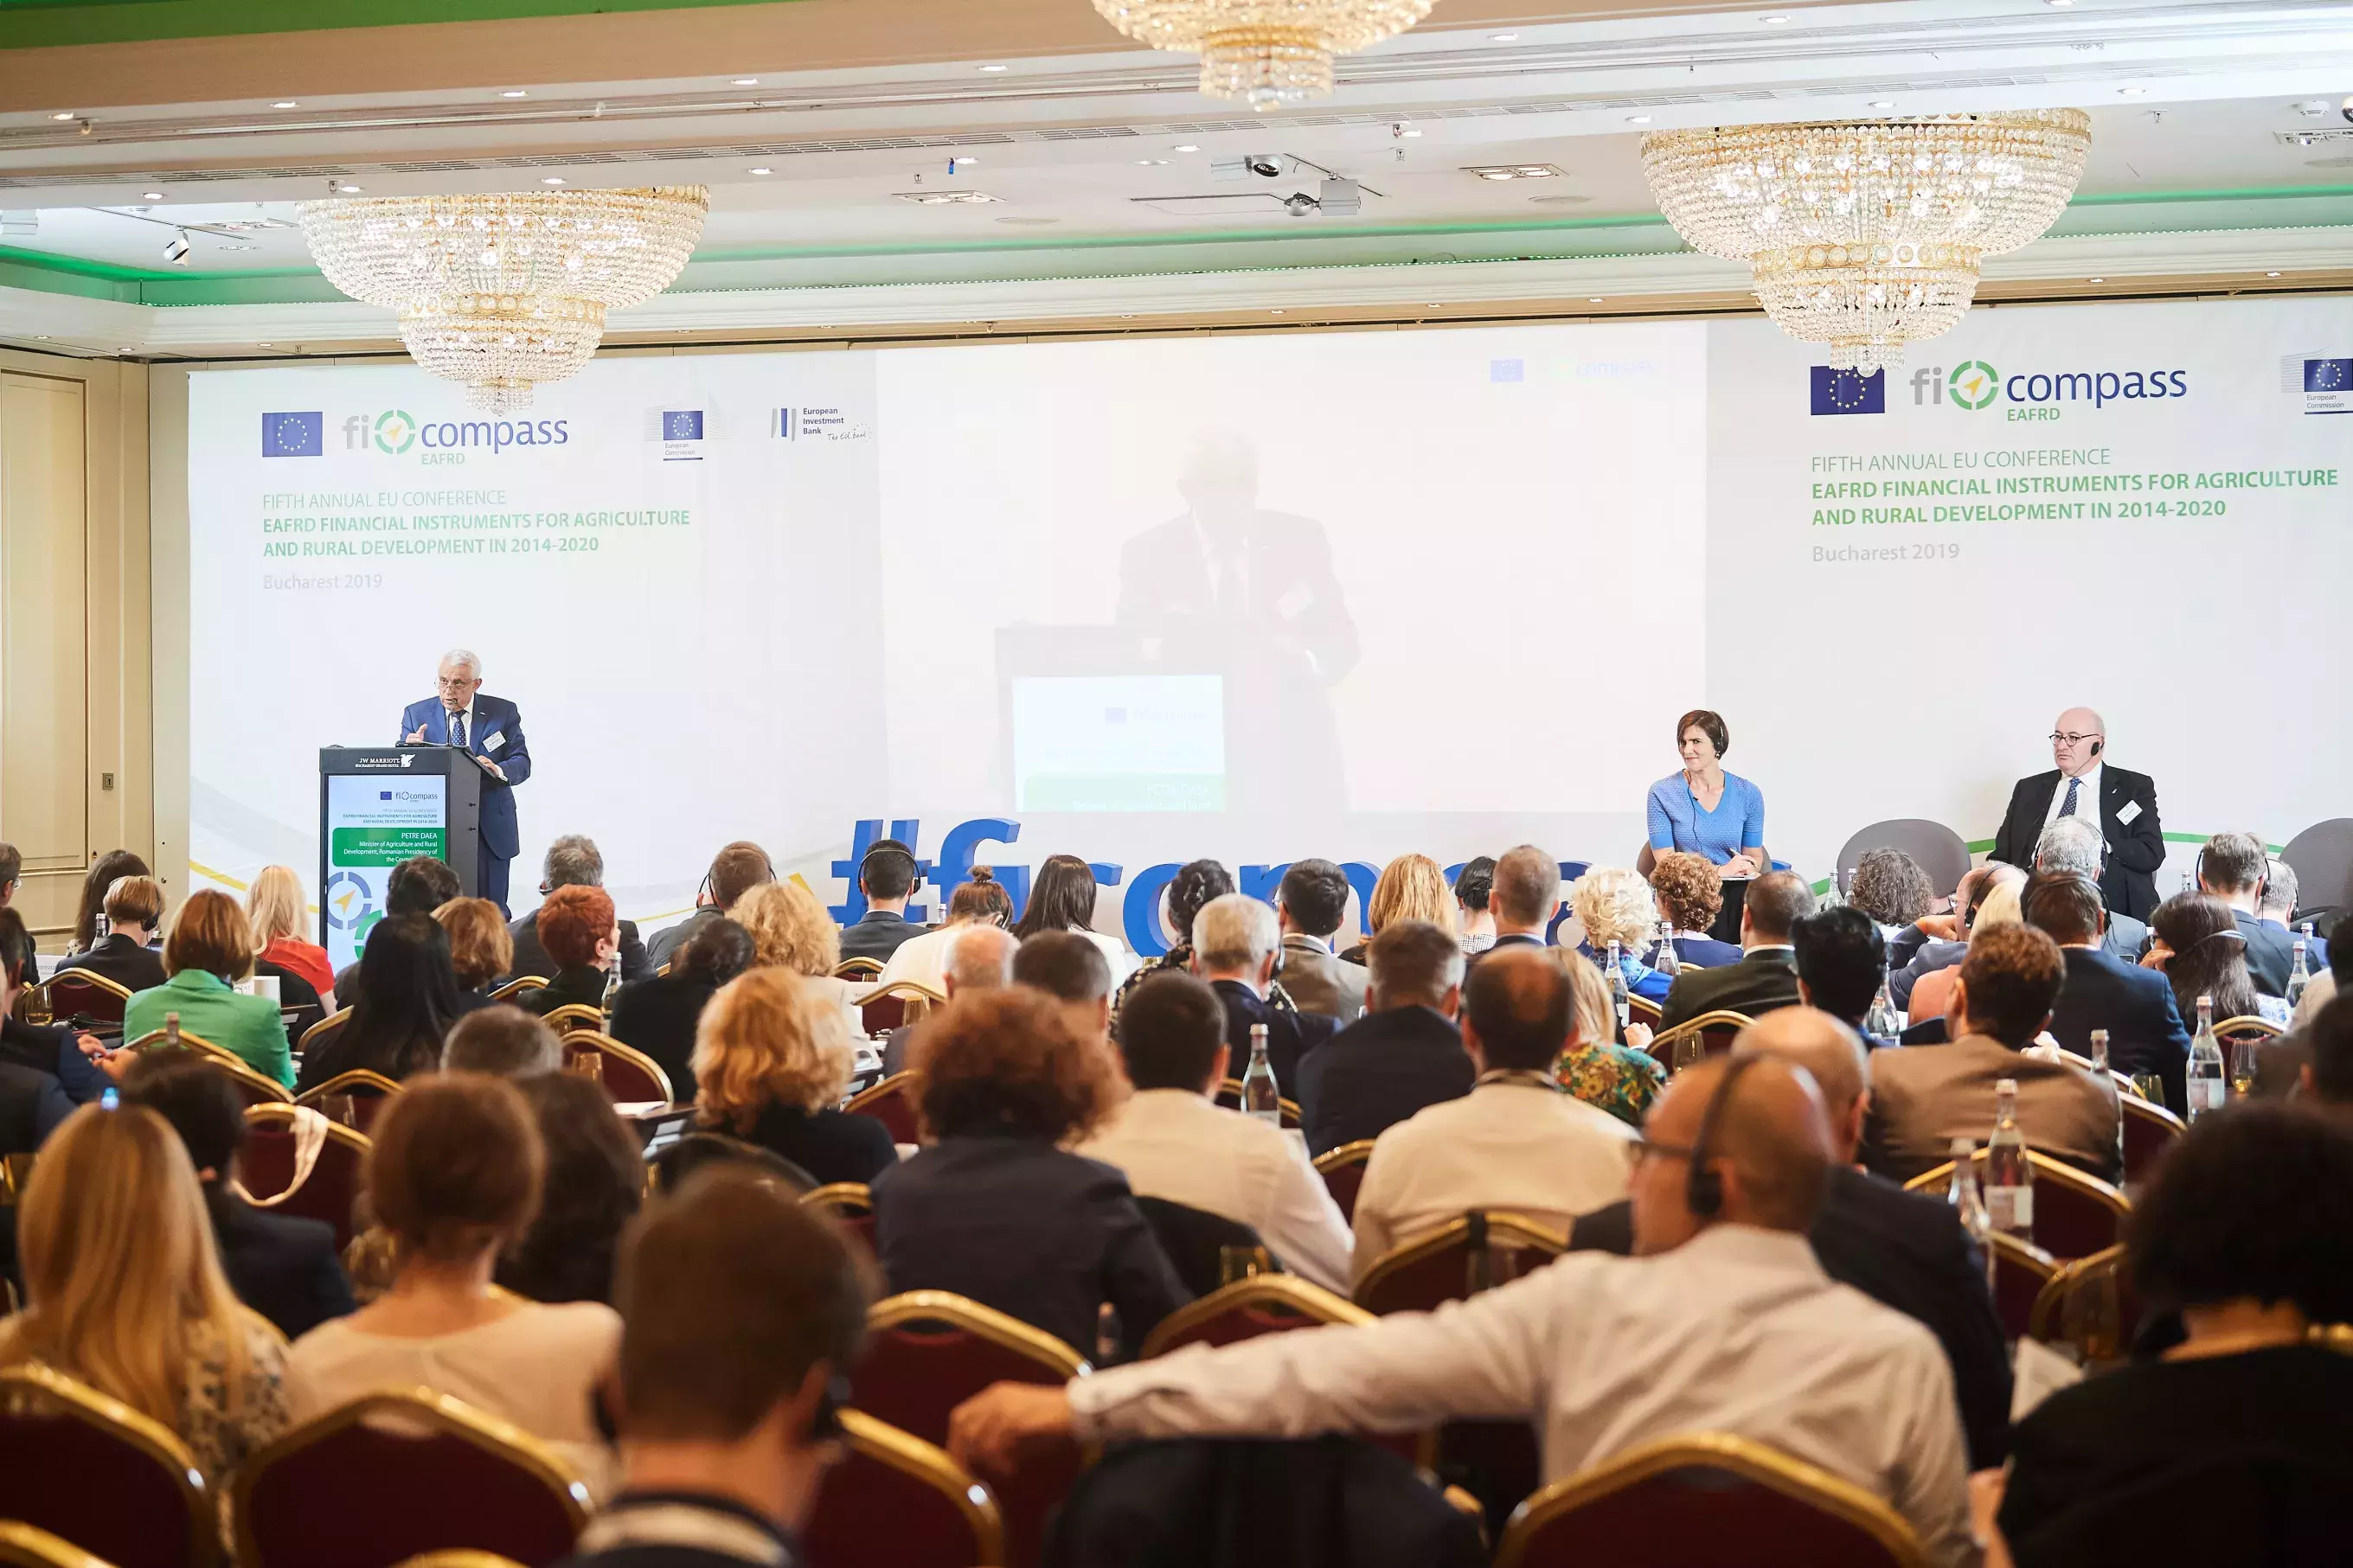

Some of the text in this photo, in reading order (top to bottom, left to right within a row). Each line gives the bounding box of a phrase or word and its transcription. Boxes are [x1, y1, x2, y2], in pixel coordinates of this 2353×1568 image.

[1909, 367, 2188, 409] fi compass
[803, 407, 838, 417] European
[803, 417, 844, 426] Investment
[2006, 408, 2061, 422] EAFRD
[342, 414, 568, 454] fi compass
[421, 452, 465, 465] EAFRD
[1812, 449, 2111, 473] FIFTH ANNUAL EU CONFERENCE
[1812, 469, 2338, 499] EAFRD FINANCIAL INSTRUMENTS FOR AGRICULTURE
[263, 490, 507, 510] FIFTH ANNUAL EU CONFERENCE
[263, 510, 690, 533] EAFRD FINANCIAL INSTRUMENTS FOR AGRICULTURE
[1812, 500, 2226, 526] AND RURAL DEVELOPMENT IN 2014-2020
[263, 537, 599, 557] AND RURAL DEVELOPMENT IN 2014-2020
[1812, 543, 1960, 562] Bucharest 2019
[263, 573, 383, 591] Bucharest 2019
[409, 793, 438, 802] compass
